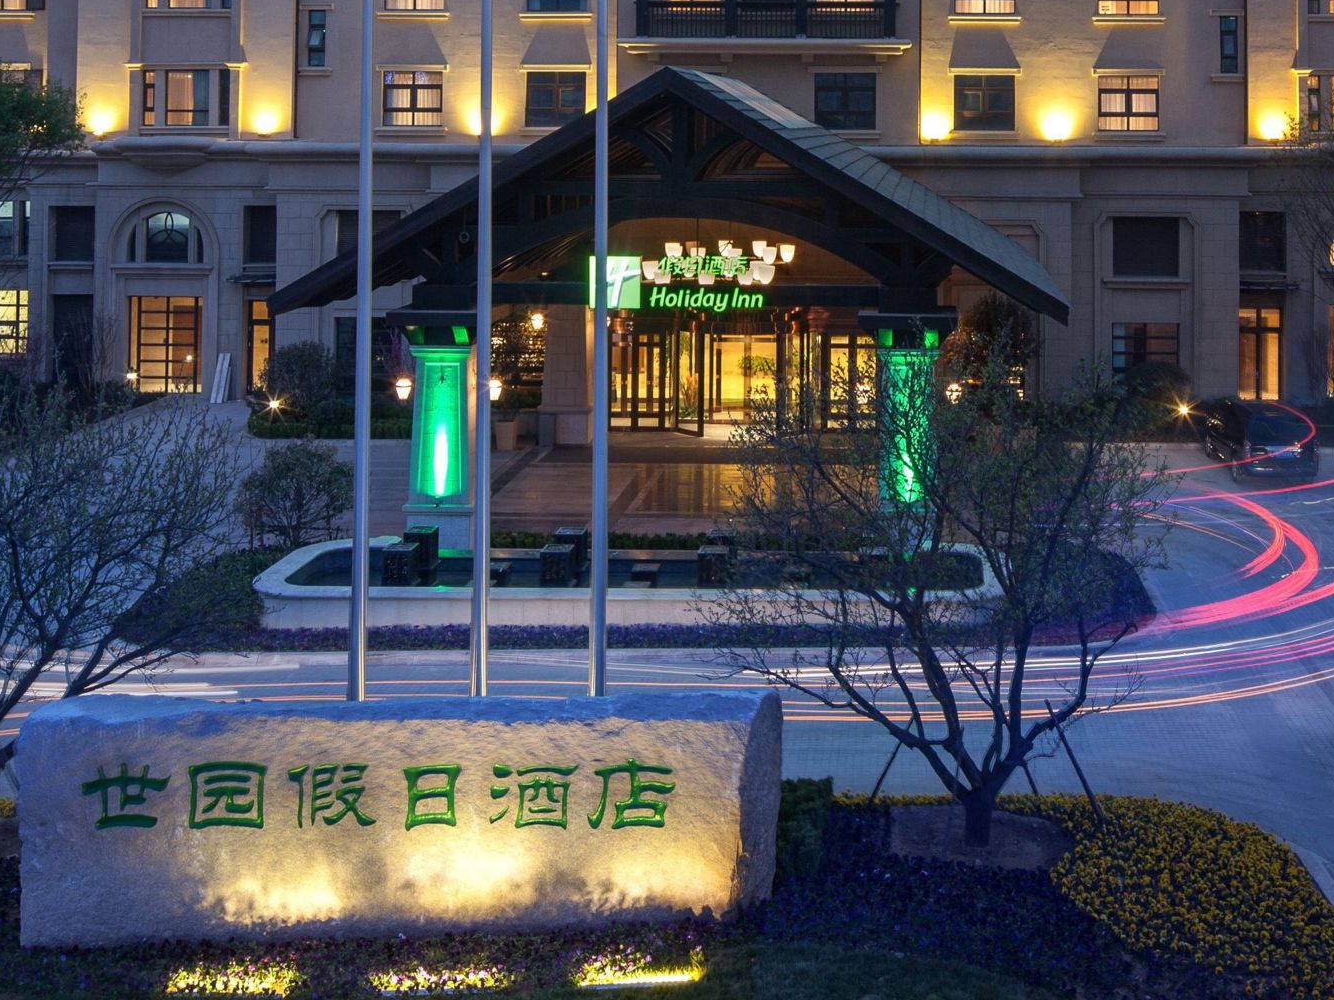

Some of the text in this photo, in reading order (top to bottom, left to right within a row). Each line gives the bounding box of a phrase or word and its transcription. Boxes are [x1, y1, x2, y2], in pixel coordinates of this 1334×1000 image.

[657, 256, 748, 276] 假日酒店
[649, 286, 764, 312] Holiday Inn
[82, 758, 676, 831] 世园假日酒店
